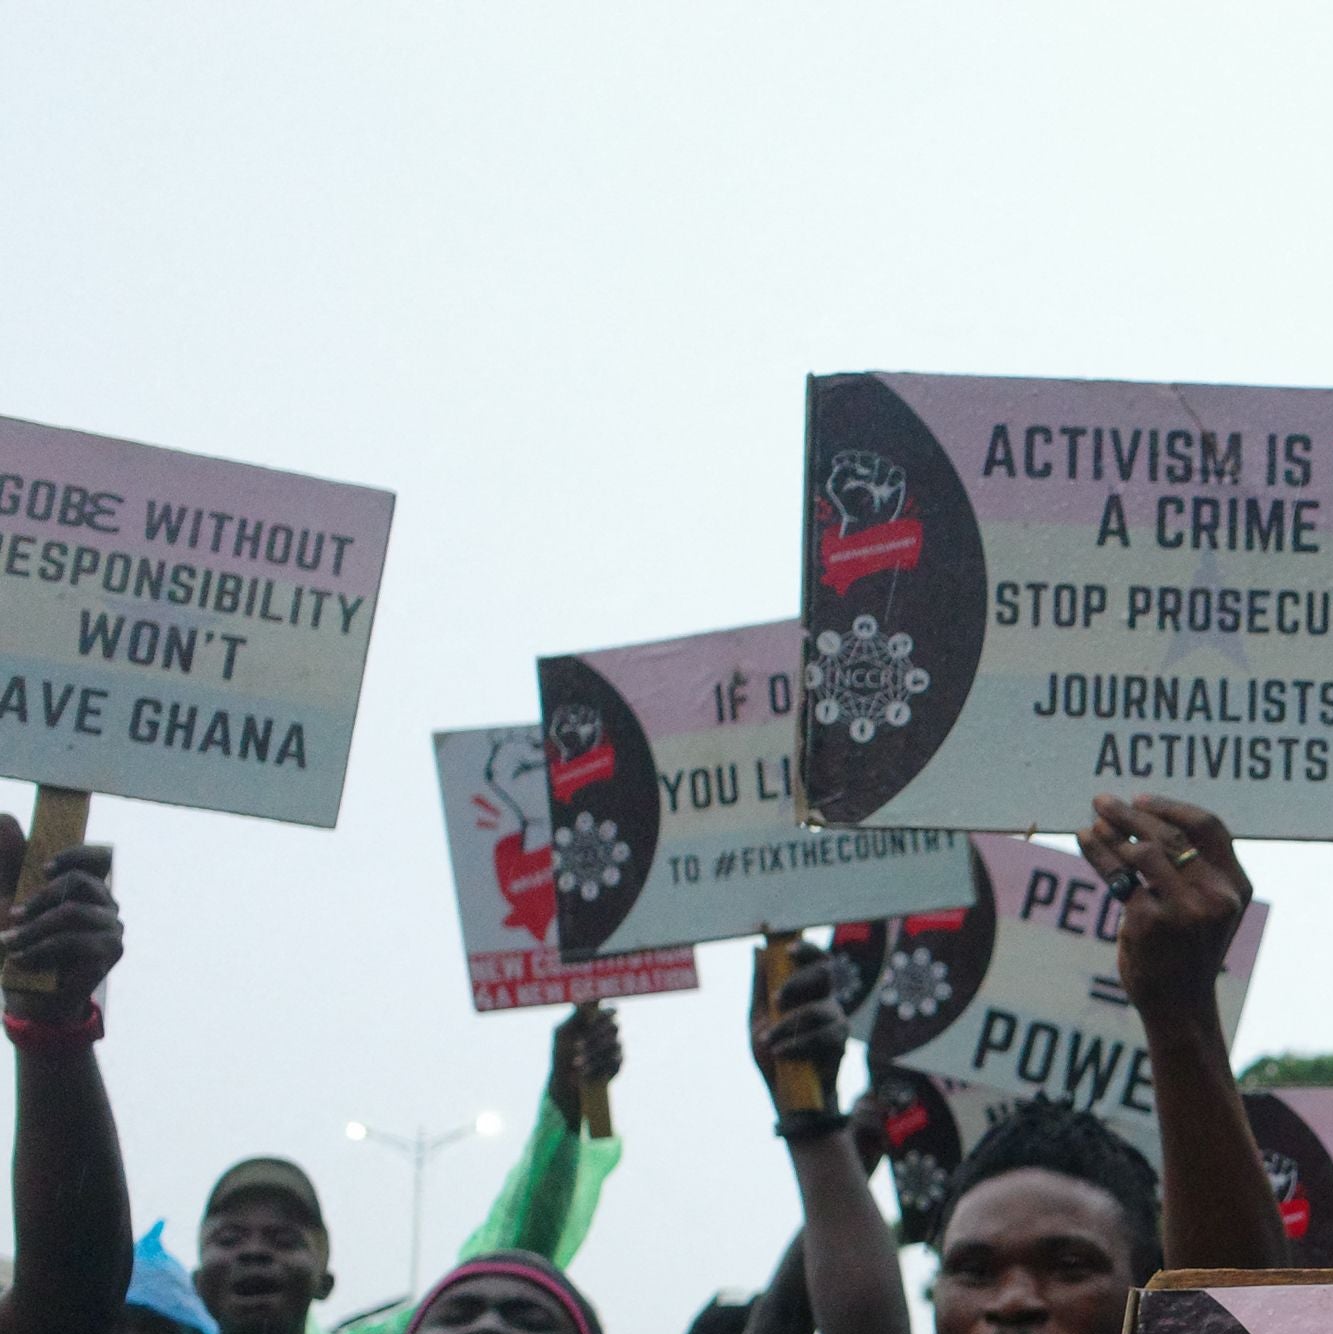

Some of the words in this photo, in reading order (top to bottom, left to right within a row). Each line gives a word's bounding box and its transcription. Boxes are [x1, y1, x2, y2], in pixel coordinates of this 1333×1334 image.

[983, 425, 1241, 485] ACTIVISM
[1268, 433, 1311, 486] IS
[145, 500, 354, 576] WITHOUT
[1097, 494, 1129, 547] A
[1157, 497, 1320, 552] CRIME
[0, 532, 364, 634] ESPONSIBILITY
[995, 583, 1106, 627] STOP
[78, 609, 246, 680] WON'T
[0, 675, 109, 735] AVE
[129, 697, 307, 768] GHANA
[714, 670, 748, 724] IF
[1095, 733, 1328, 781] ACTIVISTS
[658, 763, 738, 813] YOU
[669, 855, 699, 884] TO
[1020, 868, 1124, 943] PEO
[973, 1009, 1153, 1113] POWE
